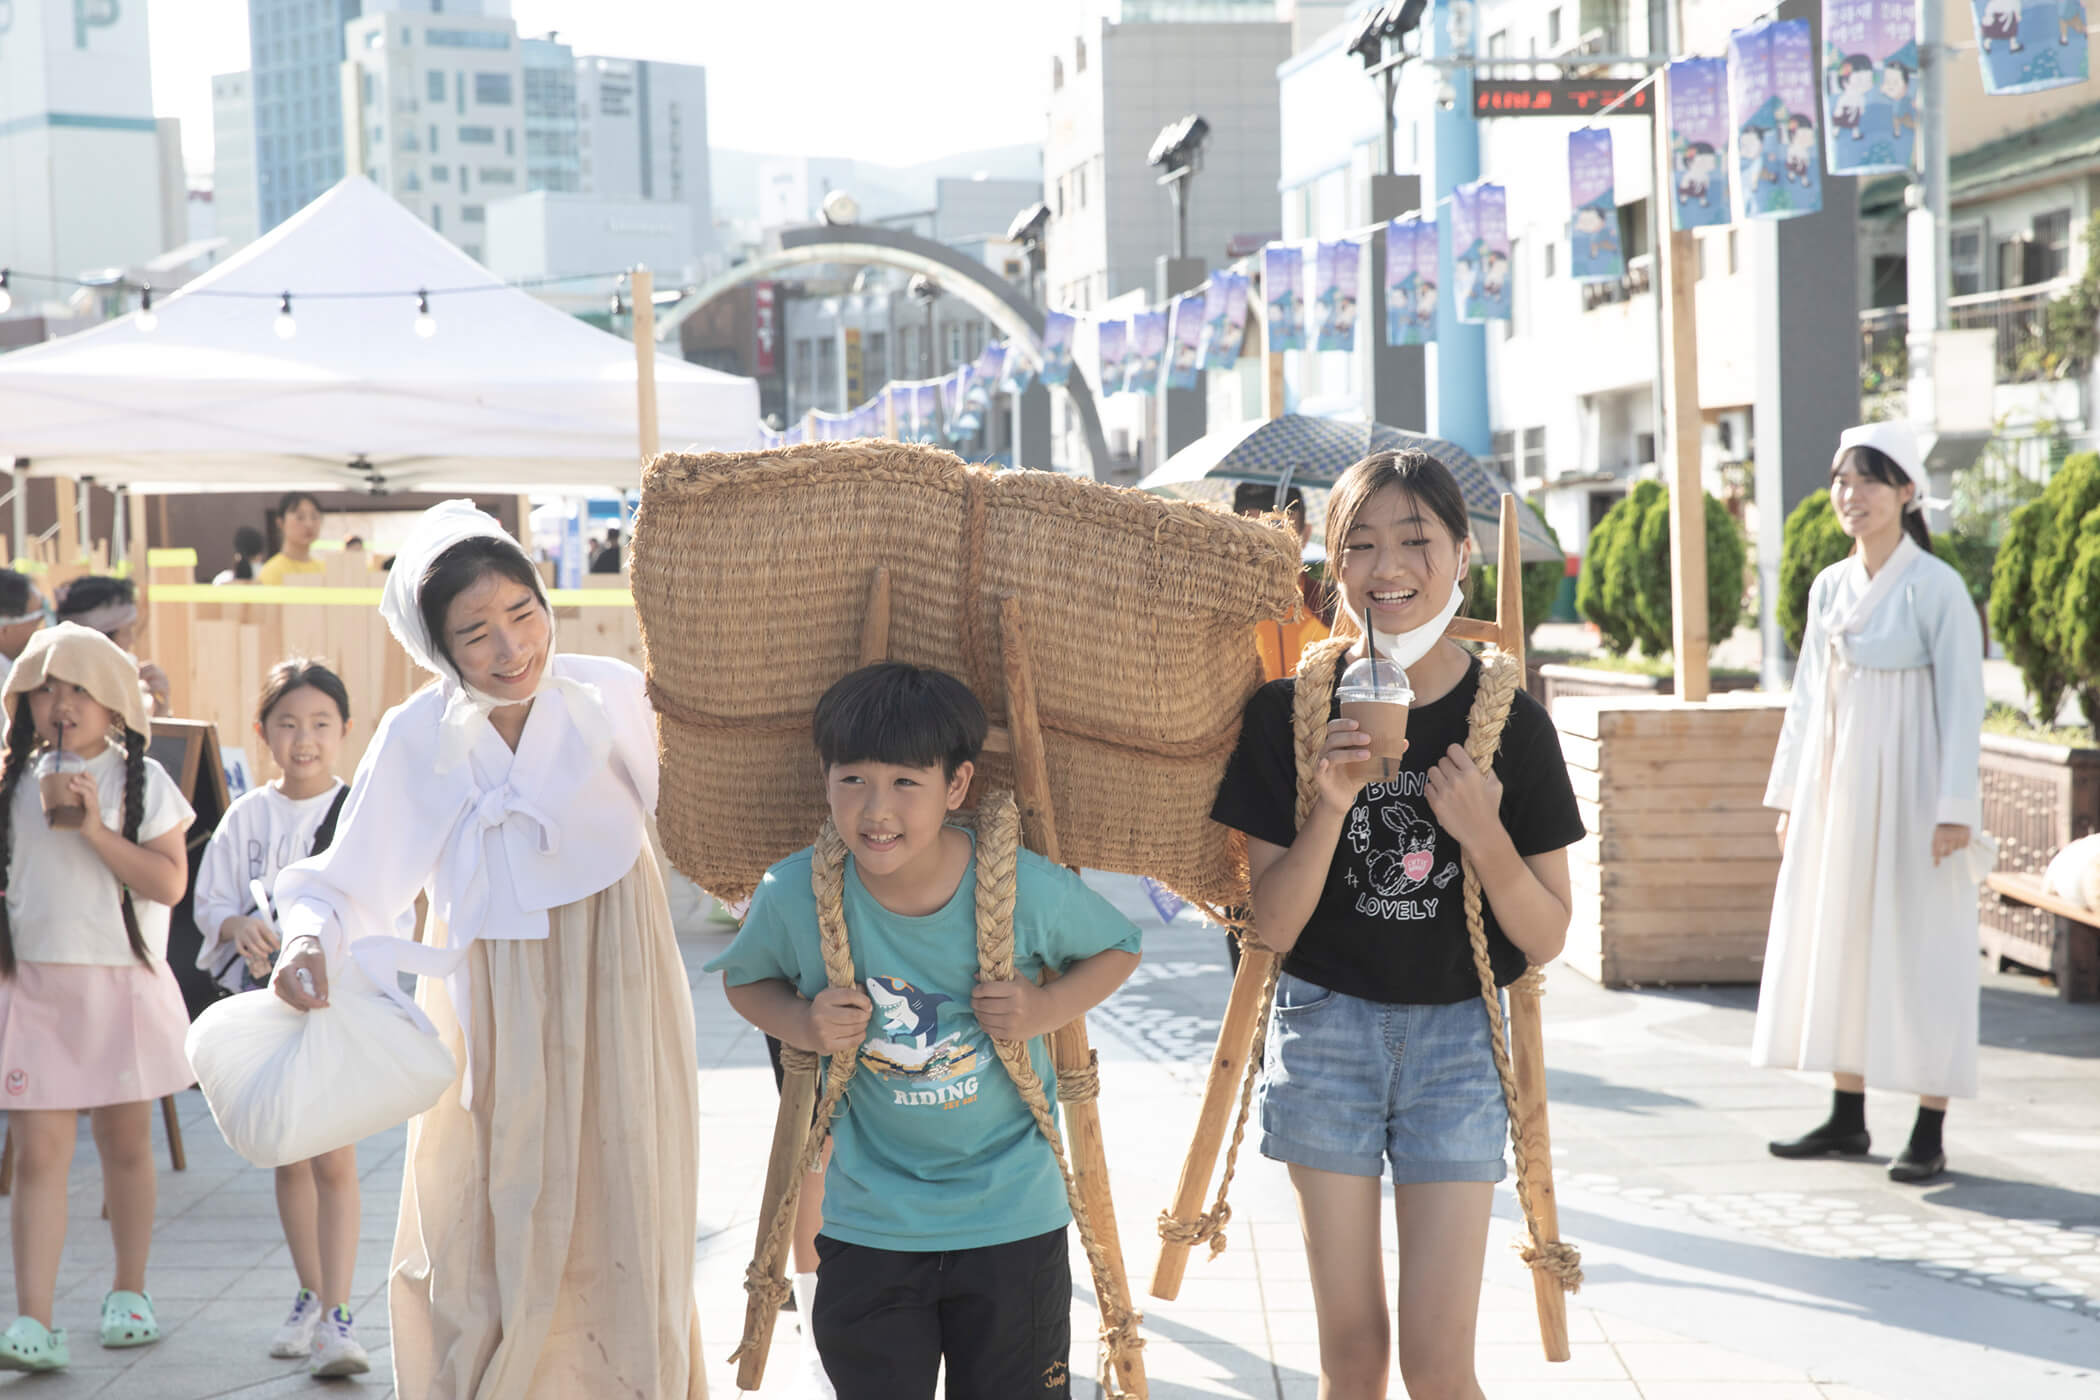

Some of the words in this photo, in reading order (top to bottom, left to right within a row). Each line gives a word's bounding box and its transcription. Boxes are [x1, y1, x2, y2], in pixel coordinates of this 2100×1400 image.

[1366, 771, 1429, 801] BUN
[1356, 892, 1439, 920] LOVELY
[893, 1077, 978, 1106] RIDING
